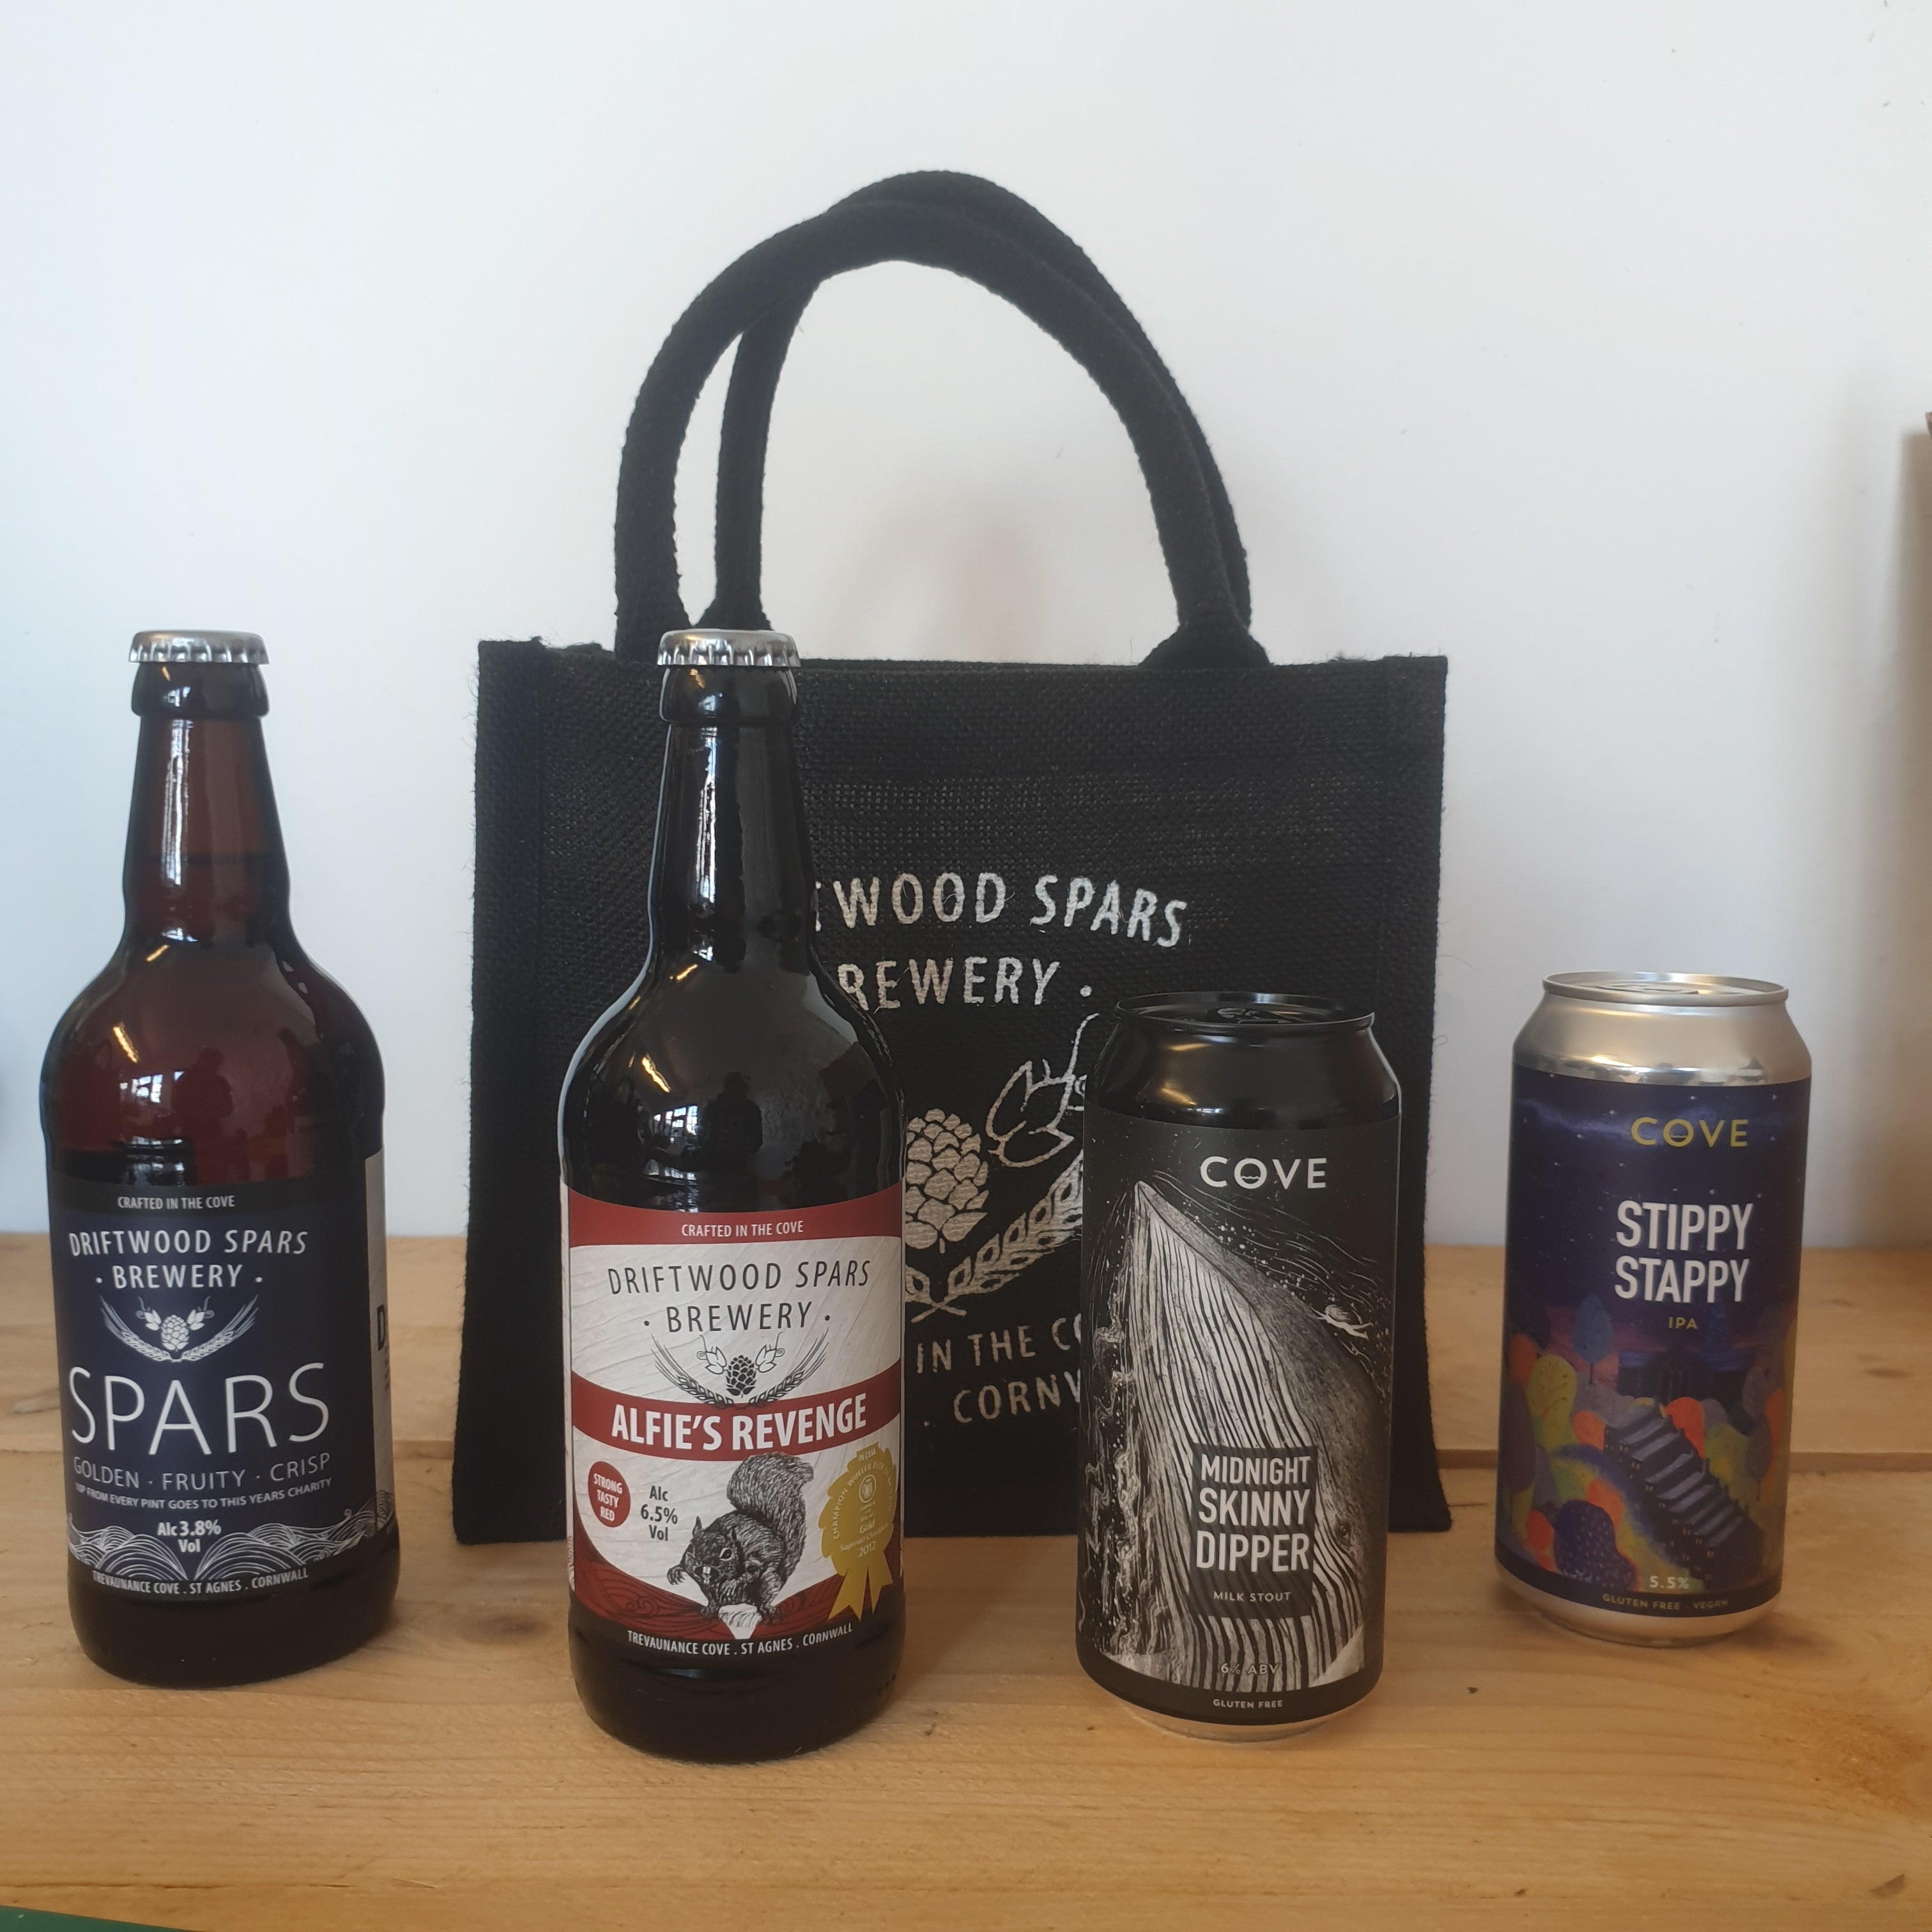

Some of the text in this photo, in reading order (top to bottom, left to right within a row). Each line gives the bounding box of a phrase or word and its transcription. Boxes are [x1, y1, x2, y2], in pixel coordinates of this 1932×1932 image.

[815, 872, 1187, 947] WOOD SPARS
[1630, 1116, 1749, 1148] COVE
[1199, 1155, 1328, 1190] COVE
[117, 1195, 236, 1210] CRAFTED IN THE COVE
[681, 1220, 804, 1238] CRAFTED IN THE COVE
[1615, 1199, 1753, 1252] STIPPY
[69, 1229, 309, 1257] DRIFTWOOD SPARS
[112, 1263, 243, 1289] BREWERY
[607, 1259, 871, 1295] DRIFTWOOD SPARS
[1614, 1255, 1750, 1304] STAPPY
[666, 1301, 813, 1333] BREWERY
[1668, 1316, 1698, 1330] IPA
[916, 1338, 952, 1374] IN
[967, 1325, 1036, 1367] THE
[68, 1362, 330, 1455] SPARS
[611, 1392, 868, 1451] ALFIE'S REVENGE
[73, 1452, 330, 1491] GOLDEN FRUITY CRISP
[1200, 1453, 1312, 1485] MIDNIGHT
[86, 1487, 109, 1501] FROM
[110, 1494, 140, 1507] EVERY
[141, 1498, 165, 1509] PINT
[167, 1499, 199, 1510] GOES
[201, 1499, 218, 1509] TO
[220, 1496, 247, 1507] THIS
[249, 1489, 286, 1504] YEARS
[287, 1476, 332, 1497] CHARITY
[593, 1473, 623, 1494] STRONG
[649, 1485, 669, 1502] Alc
[596, 1489, 619, 1508] TASTY
[1198, 1487, 1311, 1527] SKINNY
[157, 1519, 222, 1536] Alc 3.8%
[600, 1506, 615, 1522] RED
[640, 1503, 678, 1524] 6.5%
[832, 1488, 848, 1540] CHAMPION
[859, 1519, 876, 1534] Gold
[178, 1538, 201, 1553] Vol
[648, 1524, 669, 1542] Vol
[1195, 1529, 1310, 1572] DIPPER
[92, 1567, 309, 1595] TREVAUNANCE COVE ST AGNES CORNWALL
[1648, 1575, 1690, 1590] 5.5%
[1213, 1591, 1291, 1602] MILK STOUT
[1602, 1593, 1729, 1610] GLUTEN FREE VEGAN
[627, 1622, 853, 1656] TREVAUNANCE COVE ST AGNES CORNWALL
[1220, 1662, 1281, 1675] 6% ABV
[1213, 1698, 1284, 1709] GLUTEN FREE
